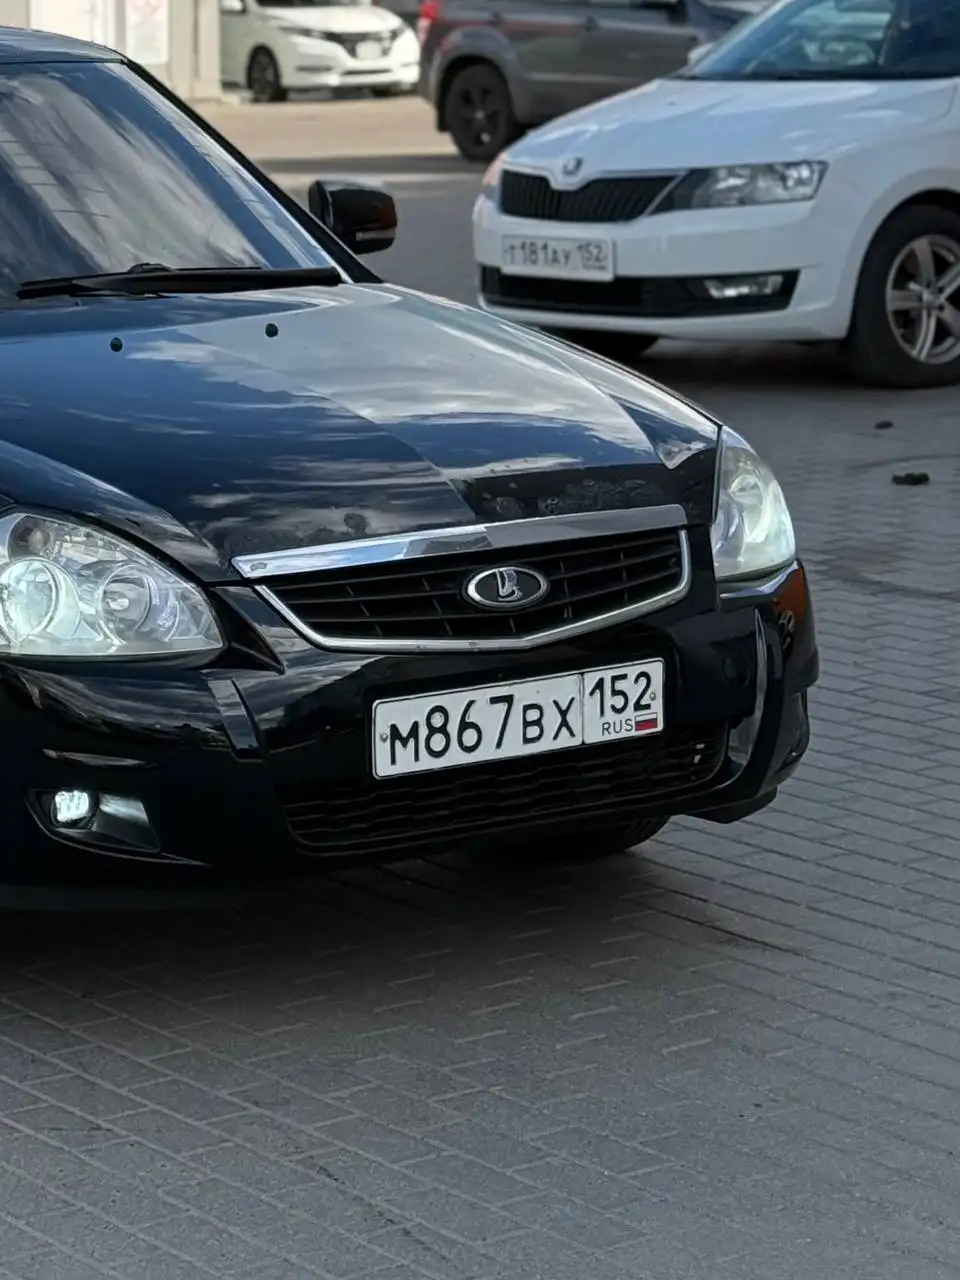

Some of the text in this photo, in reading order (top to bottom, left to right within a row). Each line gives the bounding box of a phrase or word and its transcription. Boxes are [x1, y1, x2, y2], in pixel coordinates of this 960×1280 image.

[389, 670, 652, 766] М867ВХ 152
[601, 717, 634, 737] RUS
